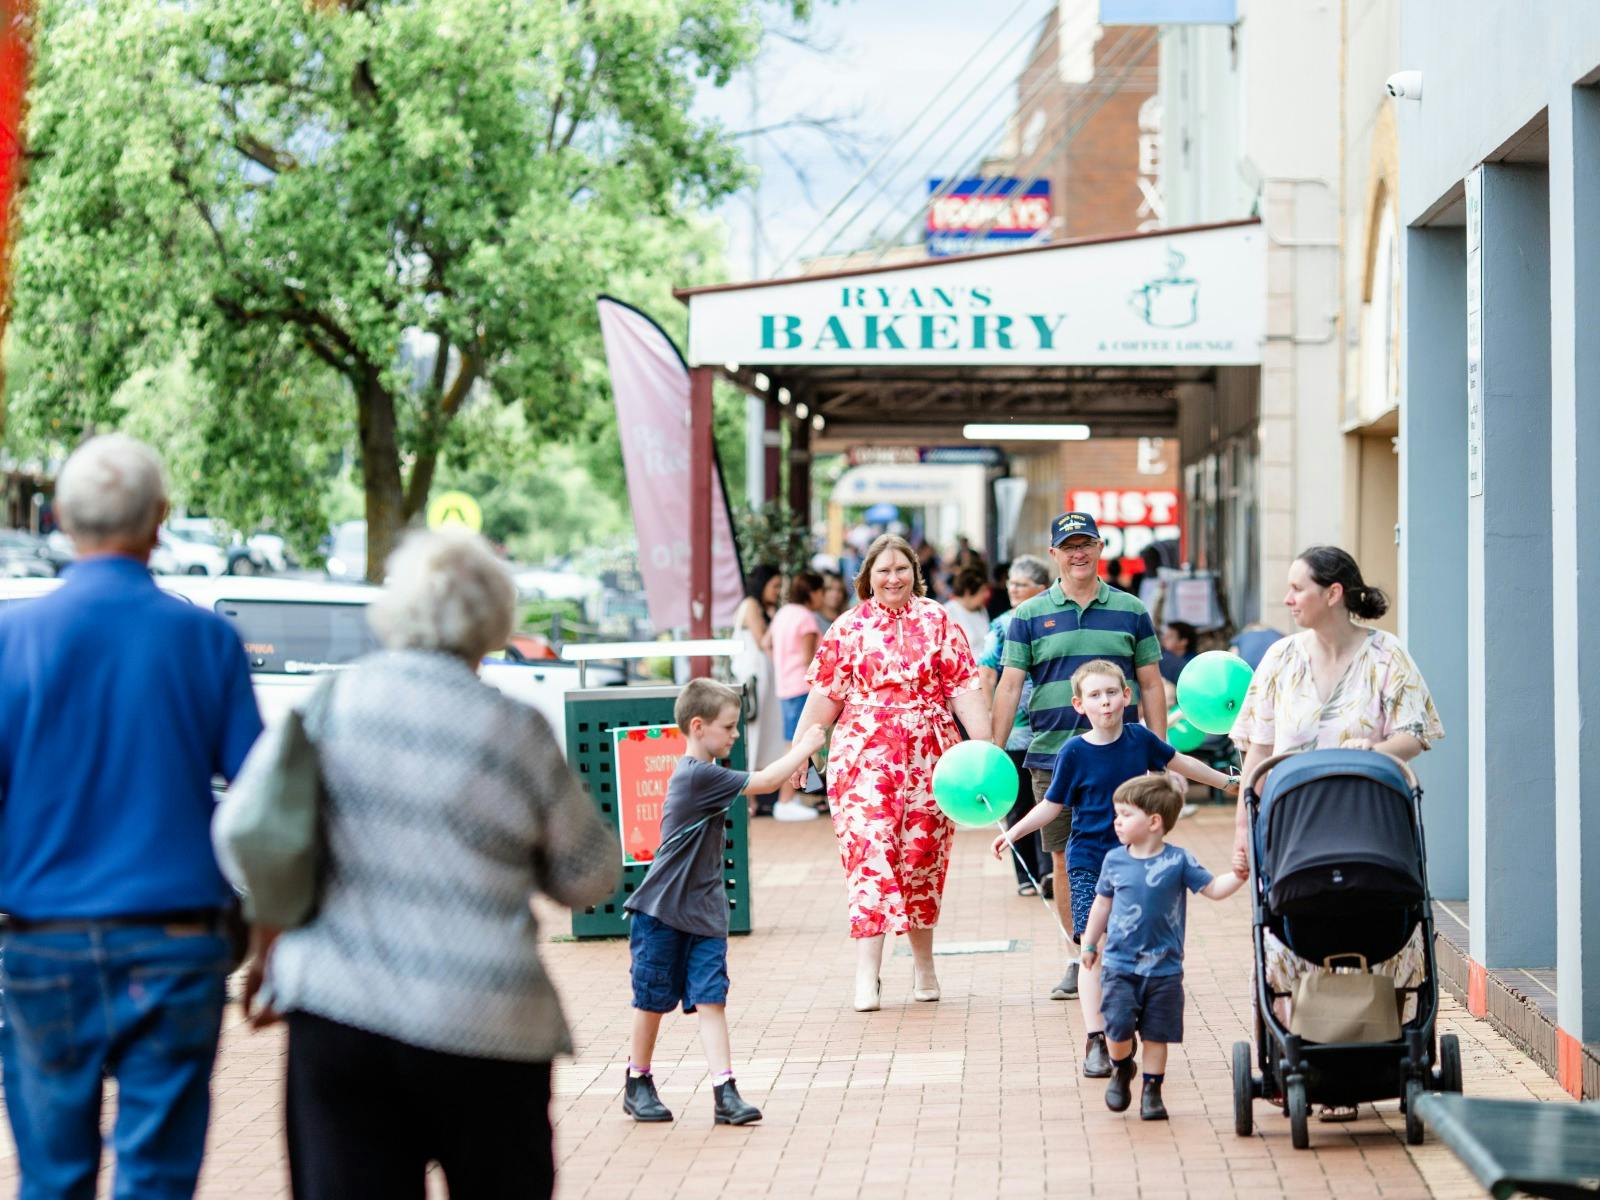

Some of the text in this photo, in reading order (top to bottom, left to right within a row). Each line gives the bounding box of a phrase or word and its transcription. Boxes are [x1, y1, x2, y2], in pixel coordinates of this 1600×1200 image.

[841, 286, 993, 308] RYAN'S
[759, 313, 1068, 351] BAKERY
[644, 754, 680, 774] SHOPPIN
[636, 779, 665, 798] LOCAL
[636, 802, 659, 822] FELT
